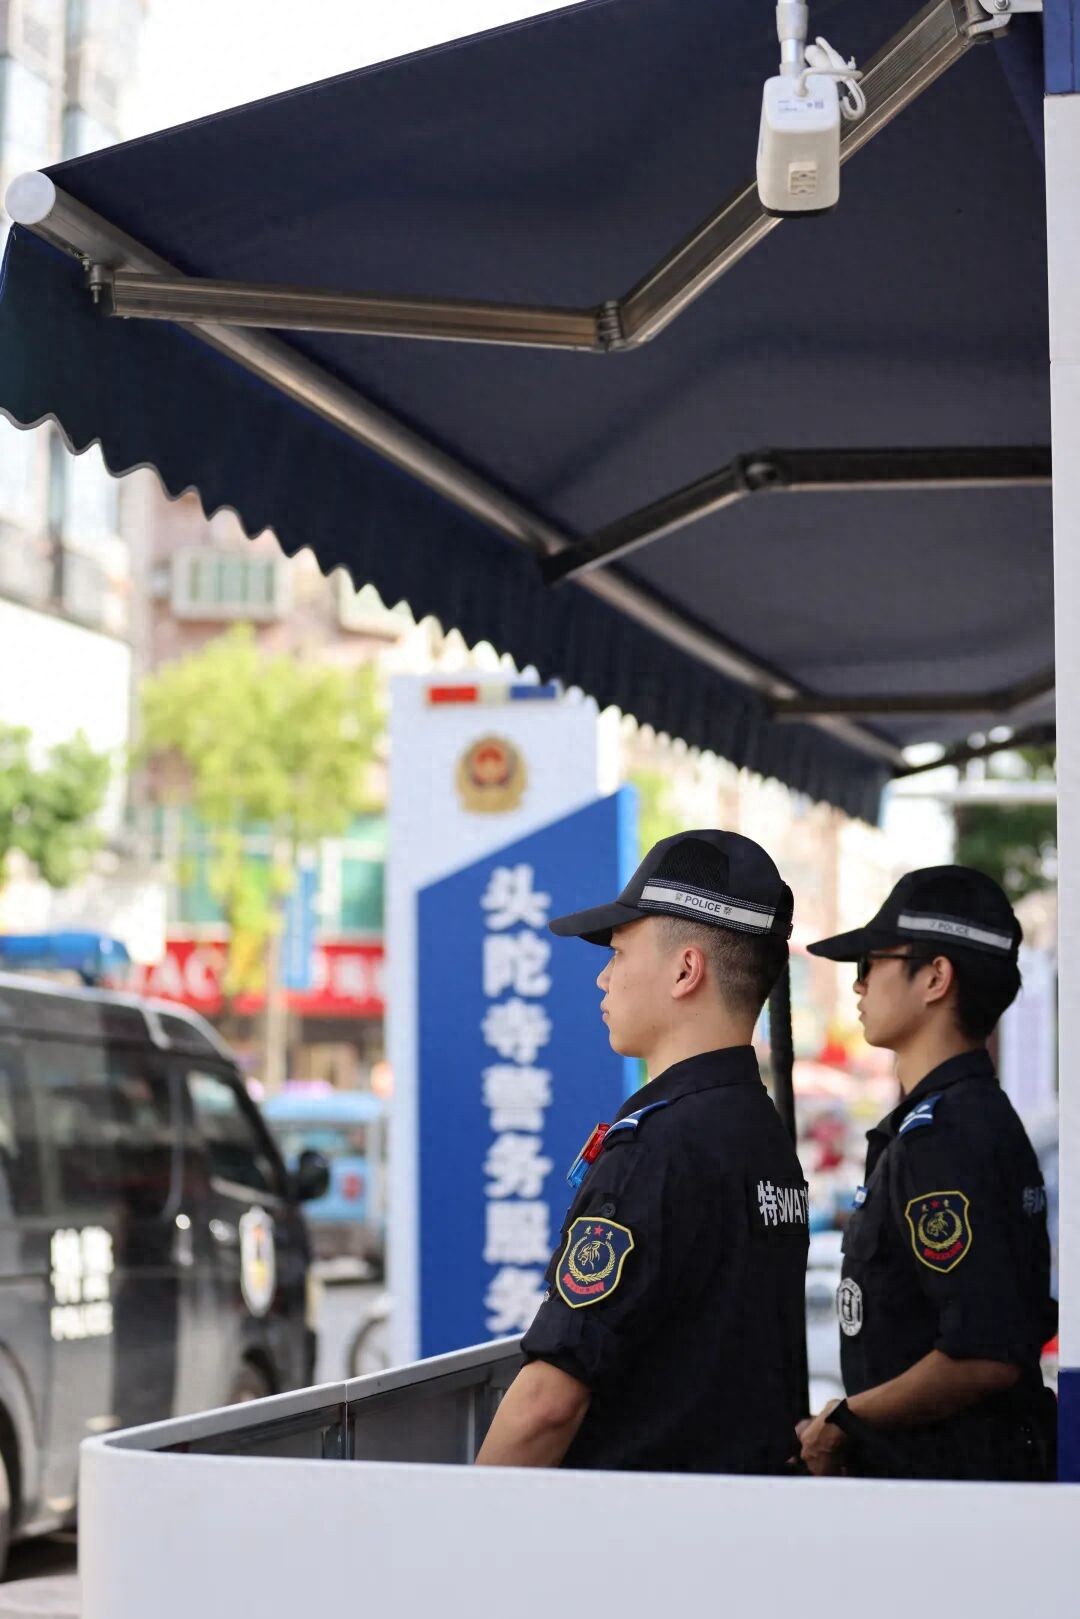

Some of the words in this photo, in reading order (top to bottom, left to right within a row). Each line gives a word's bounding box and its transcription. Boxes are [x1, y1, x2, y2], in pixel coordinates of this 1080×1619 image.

[684, 895, 721, 913] POLICE
[937, 921, 970, 937] POLICE
[480, 863, 552, 1333] 头陀寺警务服务
[757, 1180, 809, 1226] 特SWAT
